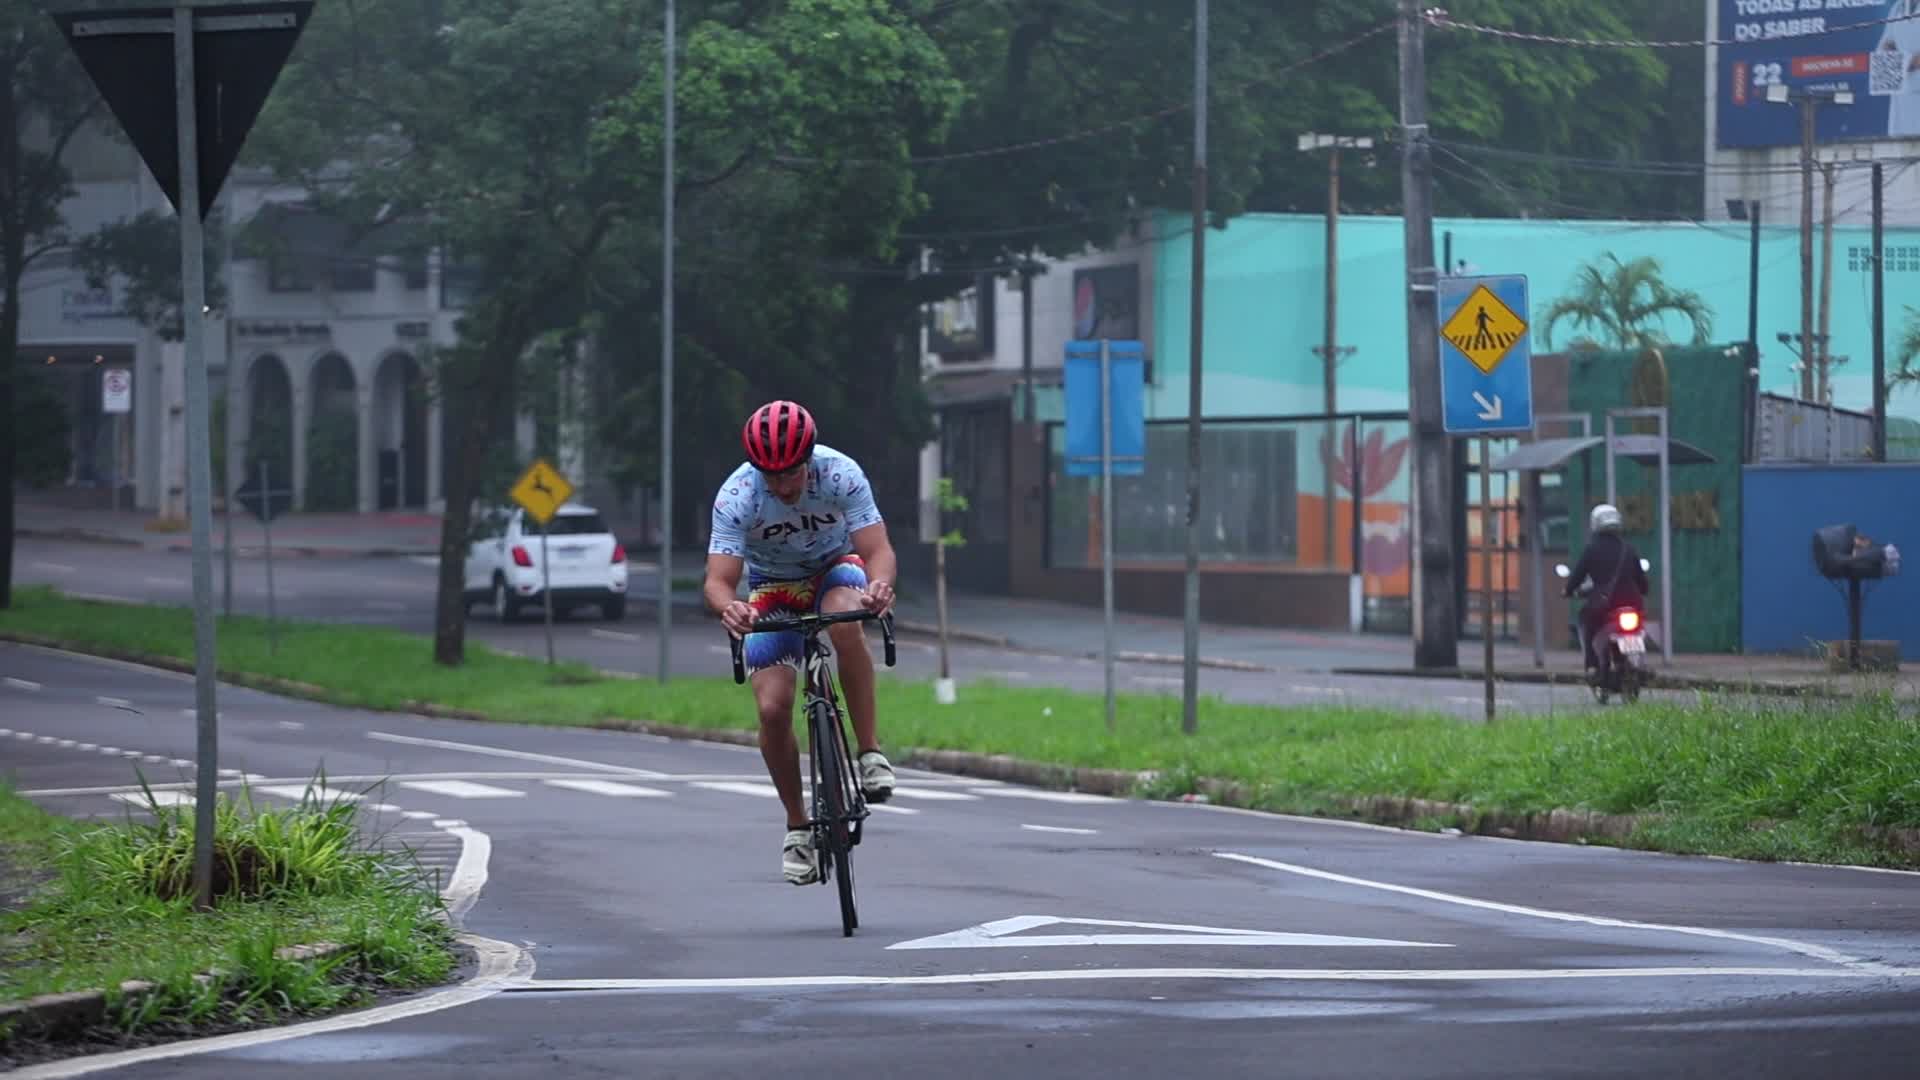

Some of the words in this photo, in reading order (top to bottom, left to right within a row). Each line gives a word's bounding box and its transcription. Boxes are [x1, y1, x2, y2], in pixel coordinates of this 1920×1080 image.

[1734, 22, 1761, 42] DO
[1763, 16, 1825, 39] SABER
[1753, 62, 1782, 86] 22
[762, 512, 838, 540] PAIN
